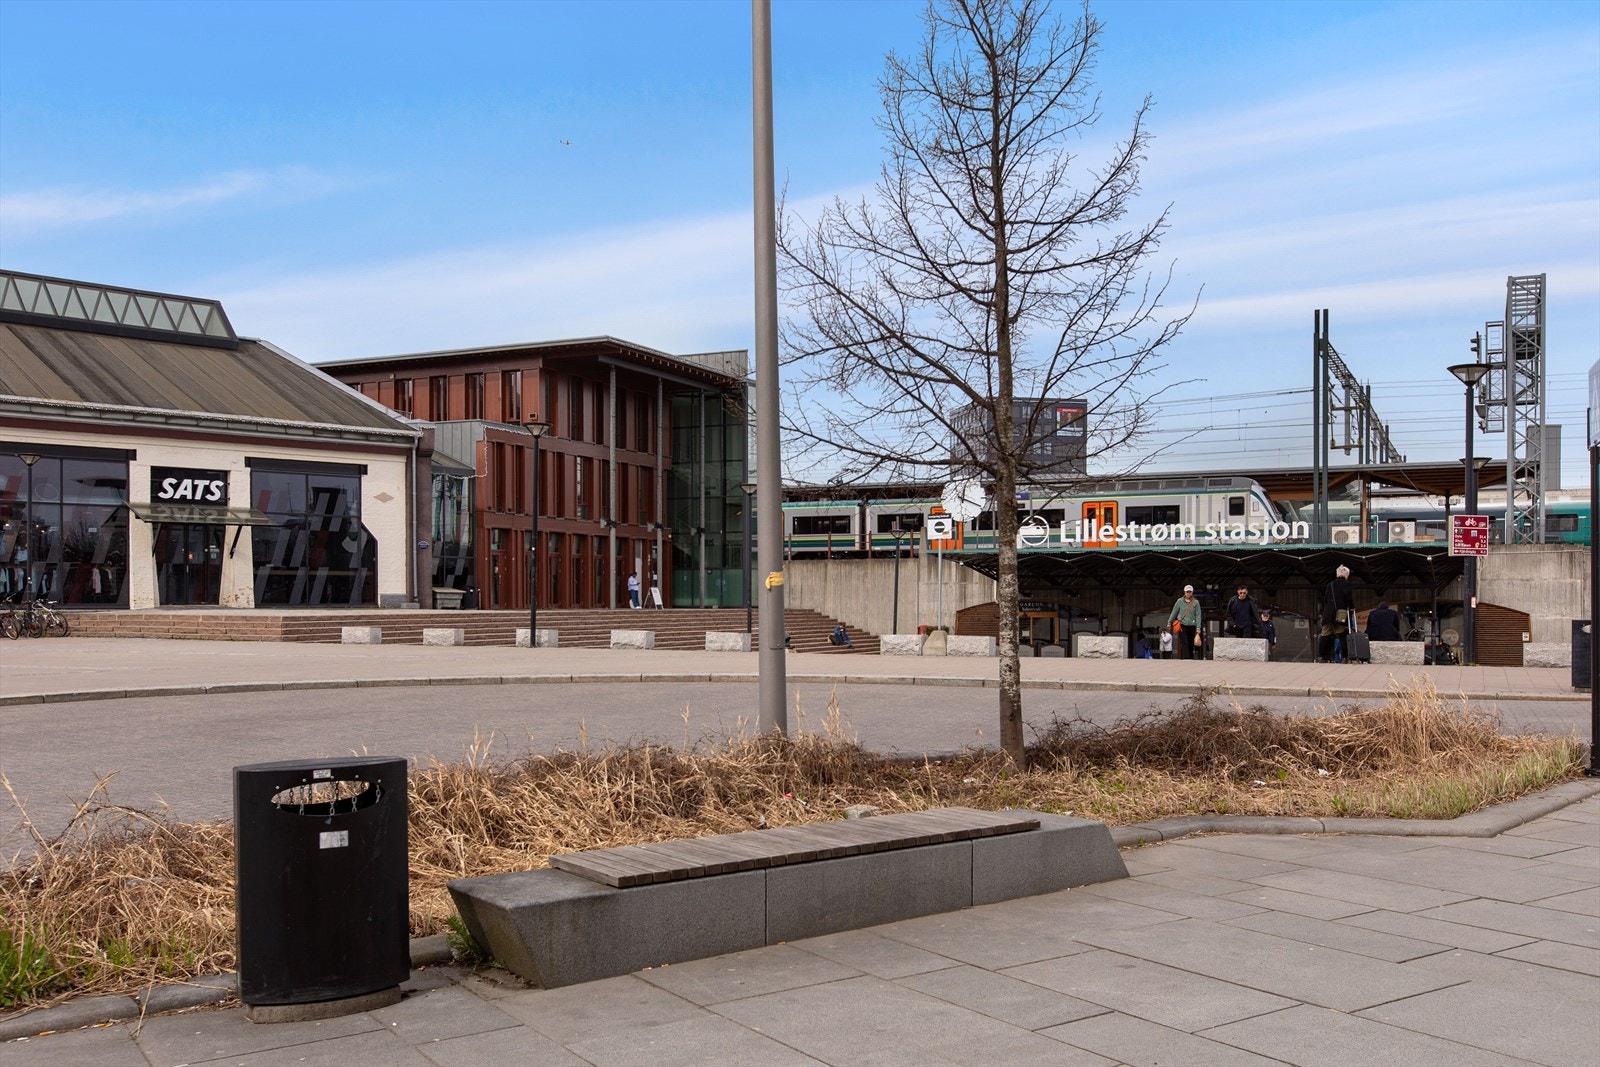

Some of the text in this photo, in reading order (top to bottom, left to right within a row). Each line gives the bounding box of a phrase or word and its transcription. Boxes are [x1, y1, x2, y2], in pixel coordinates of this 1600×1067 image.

[157, 477, 225, 501] SATS
[1059, 516, 1310, 546] Lillestrøm stasjon
